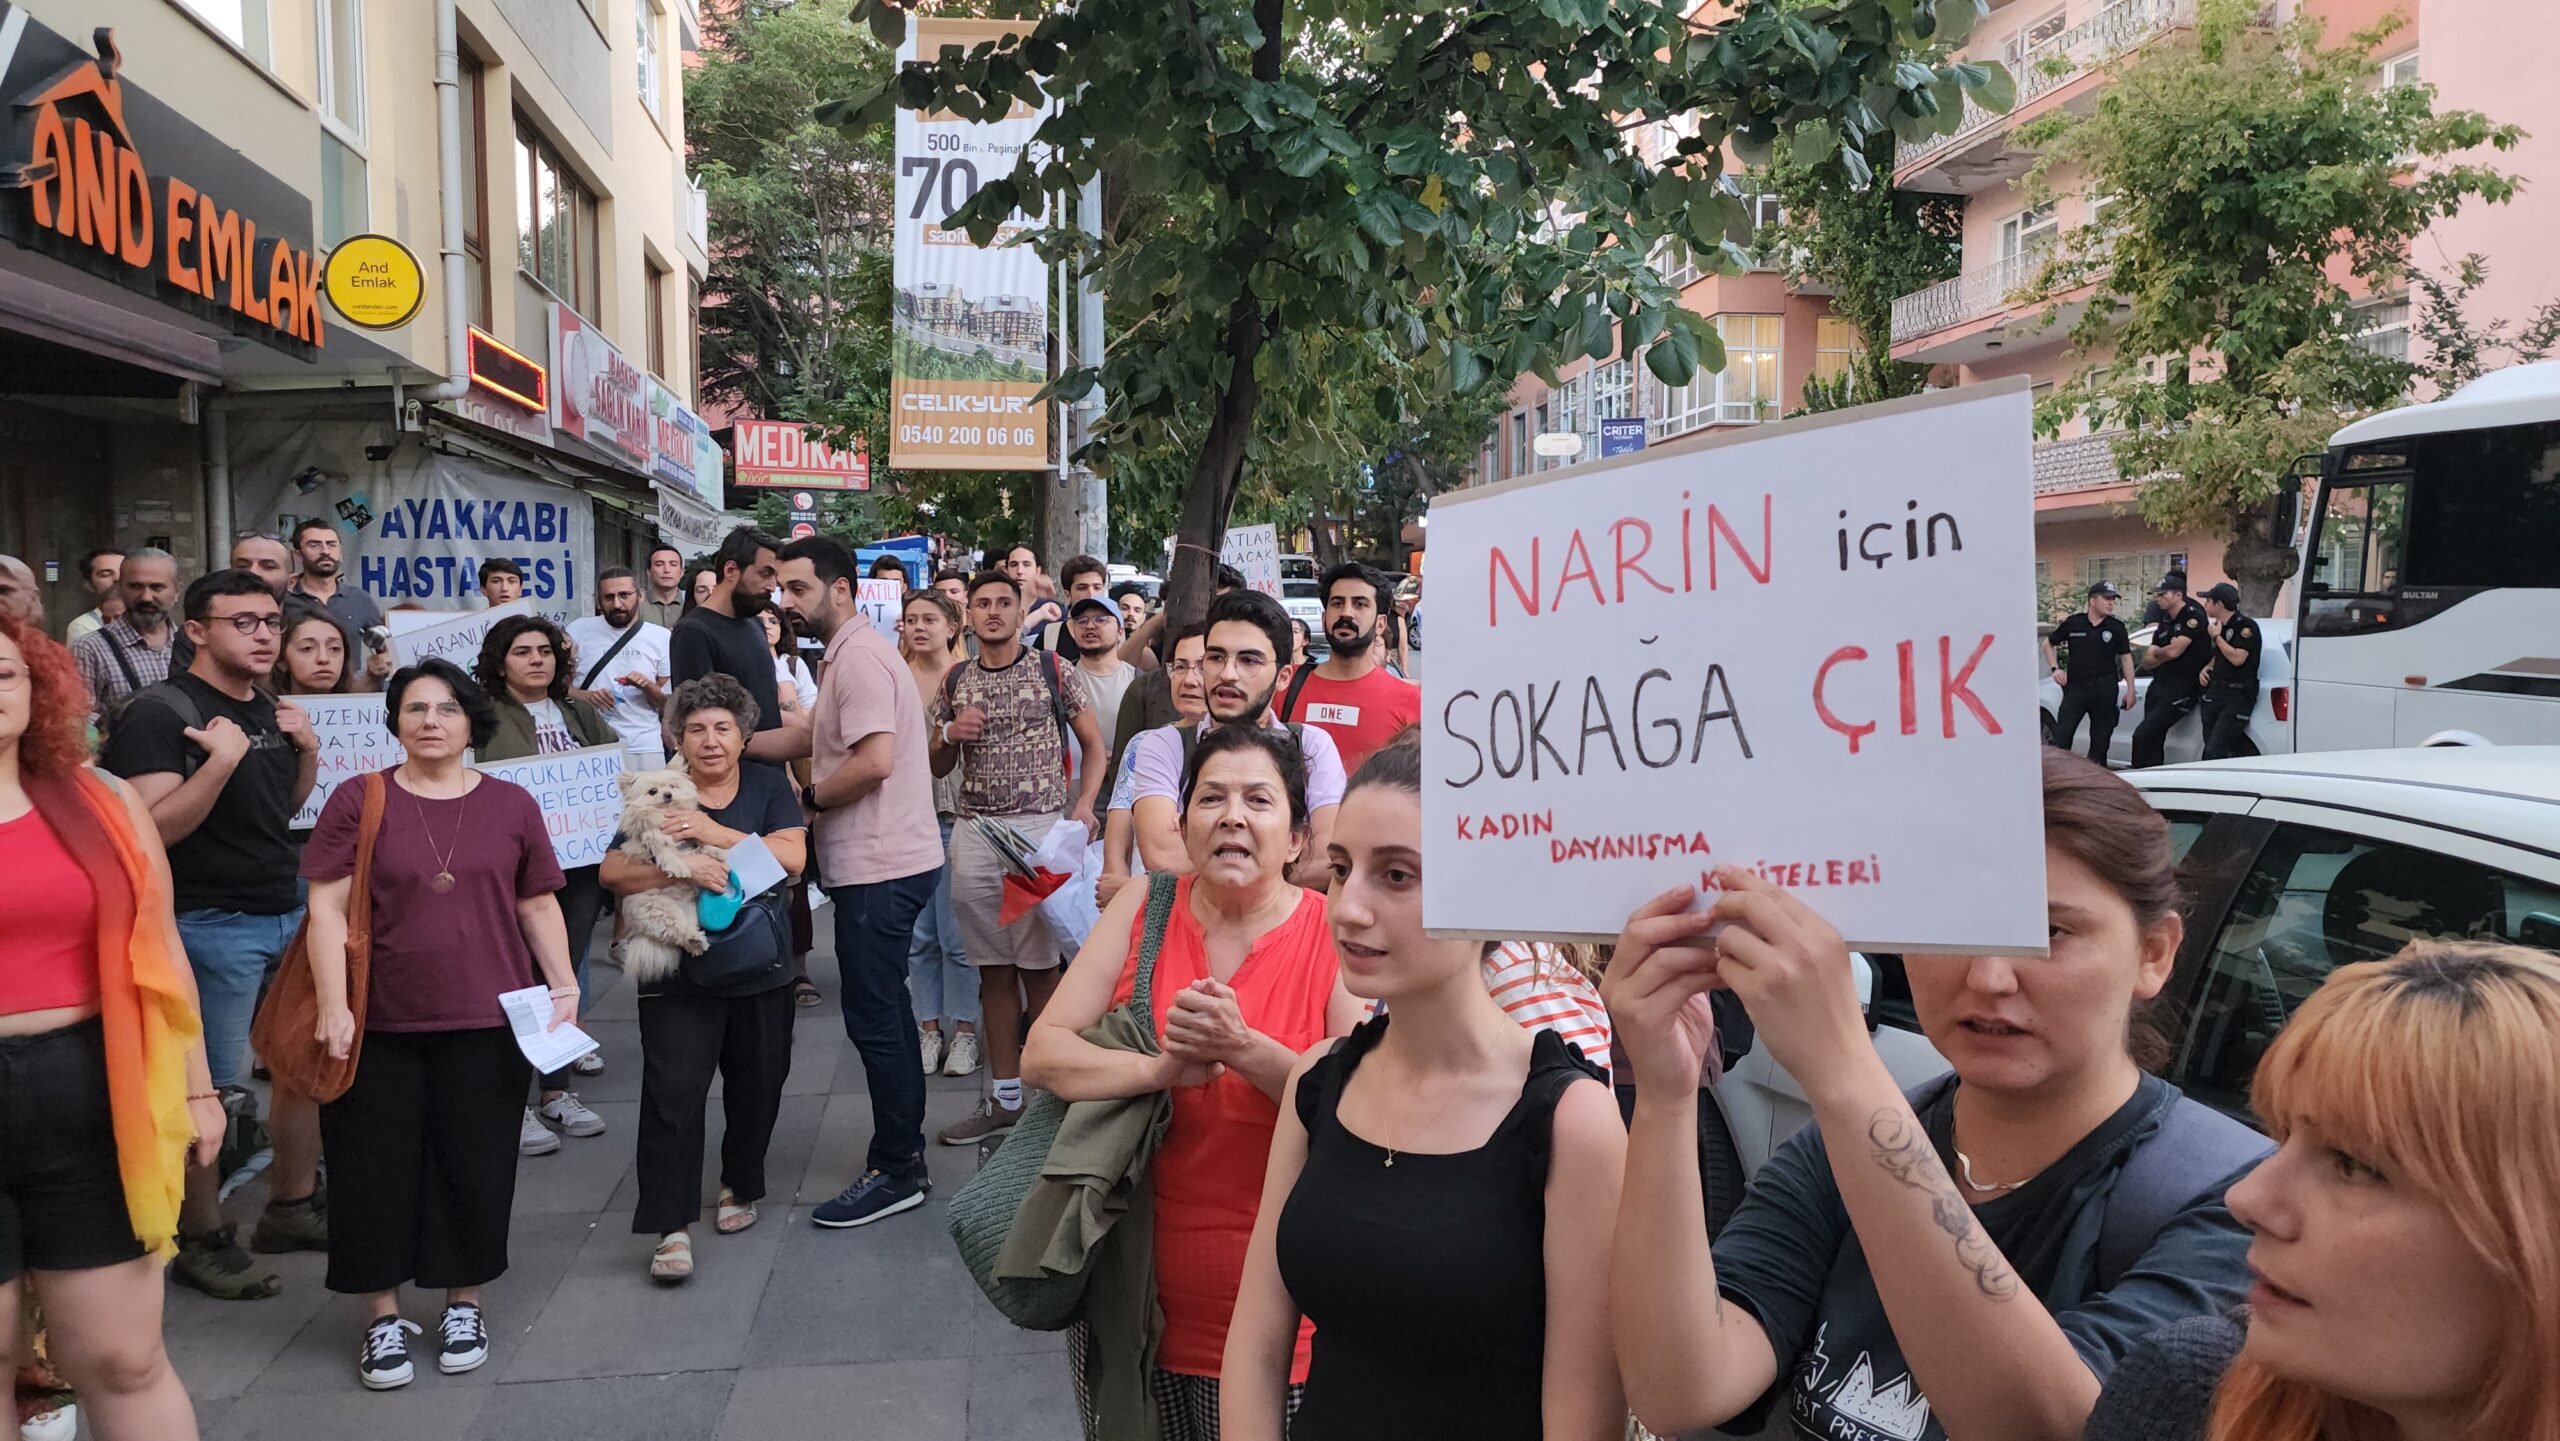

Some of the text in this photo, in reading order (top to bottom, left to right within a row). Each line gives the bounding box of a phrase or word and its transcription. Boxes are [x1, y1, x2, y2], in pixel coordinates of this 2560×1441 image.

[927, 133, 1022, 155] 500 Bin Peşinat
[902, 156, 978, 220] 70
[32, 101, 325, 349] AND EMLAK
[351, 275, 396, 288] Emlak
[359, 261, 388, 274] And
[901, 424, 1035, 447] 0540 200 06 06
[1603, 425, 1643, 436] CRITER
[380, 498, 569, 543] AYAKKABI
[360, 549, 574, 600] HASTAESİ
[1487, 489, 1963, 628] NARİN için
[2402, 591, 2439, 599] SULTAN
[553, 611, 567, 622] 67
[1444, 634, 2004, 788] SOKAĞA ÇIK
[487, 755, 622, 788] OCUKLARIN
[1457, 809, 1553, 841] KADIN
[1552, 832, 1711, 864] DAYANIŞMA
[1701, 854, 1881, 893] KİTELERİ
